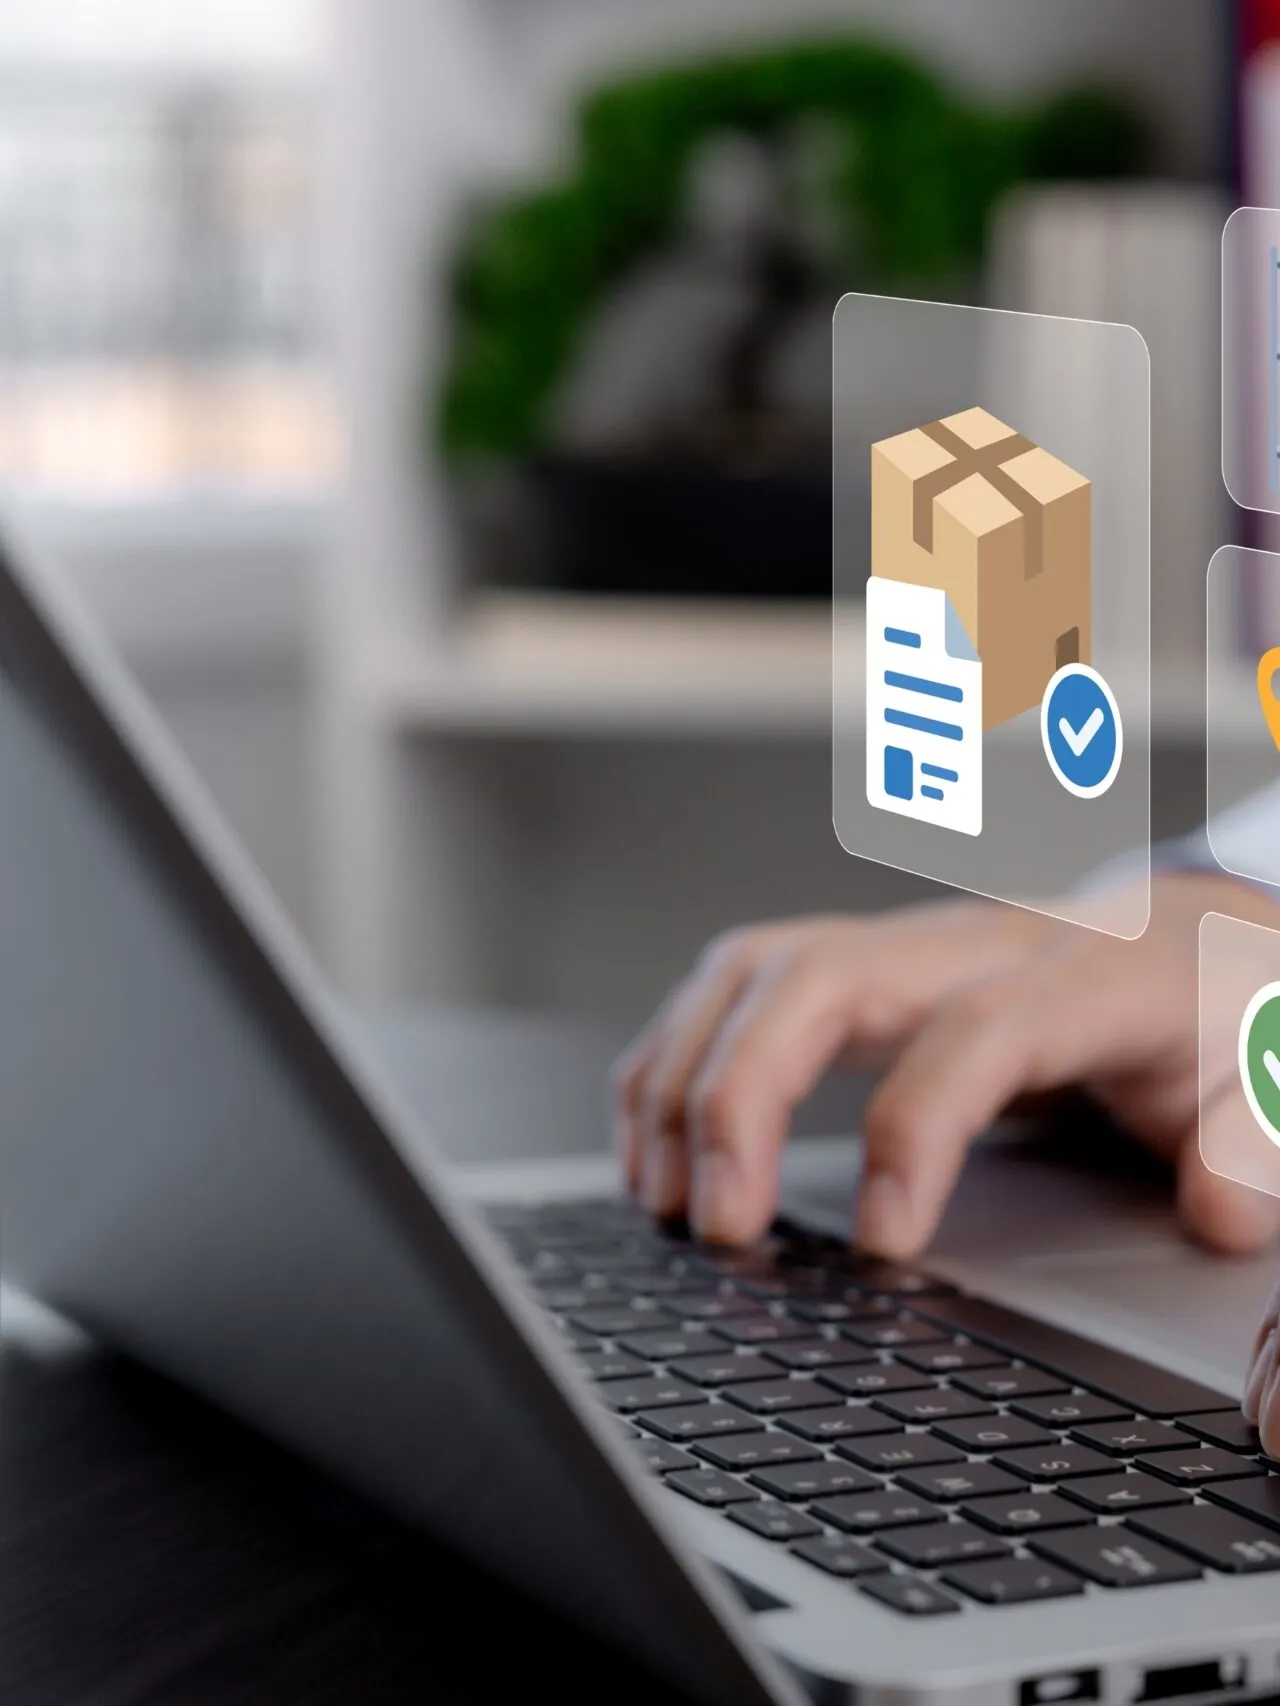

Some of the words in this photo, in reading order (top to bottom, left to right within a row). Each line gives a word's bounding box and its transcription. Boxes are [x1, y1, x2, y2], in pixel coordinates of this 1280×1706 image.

[915, 1405, 946, 1414] F
[1051, 1406, 1080, 1417] C
[820, 1420, 851, 1432] R
[977, 1431, 1008, 1442] D
[1113, 1434, 1145, 1444] X
[881, 1450, 913, 1461] E
[1041, 1460, 1070, 1470] S
[1180, 1464, 1213, 1473] Z
[1108, 1489, 1139, 1500] A
